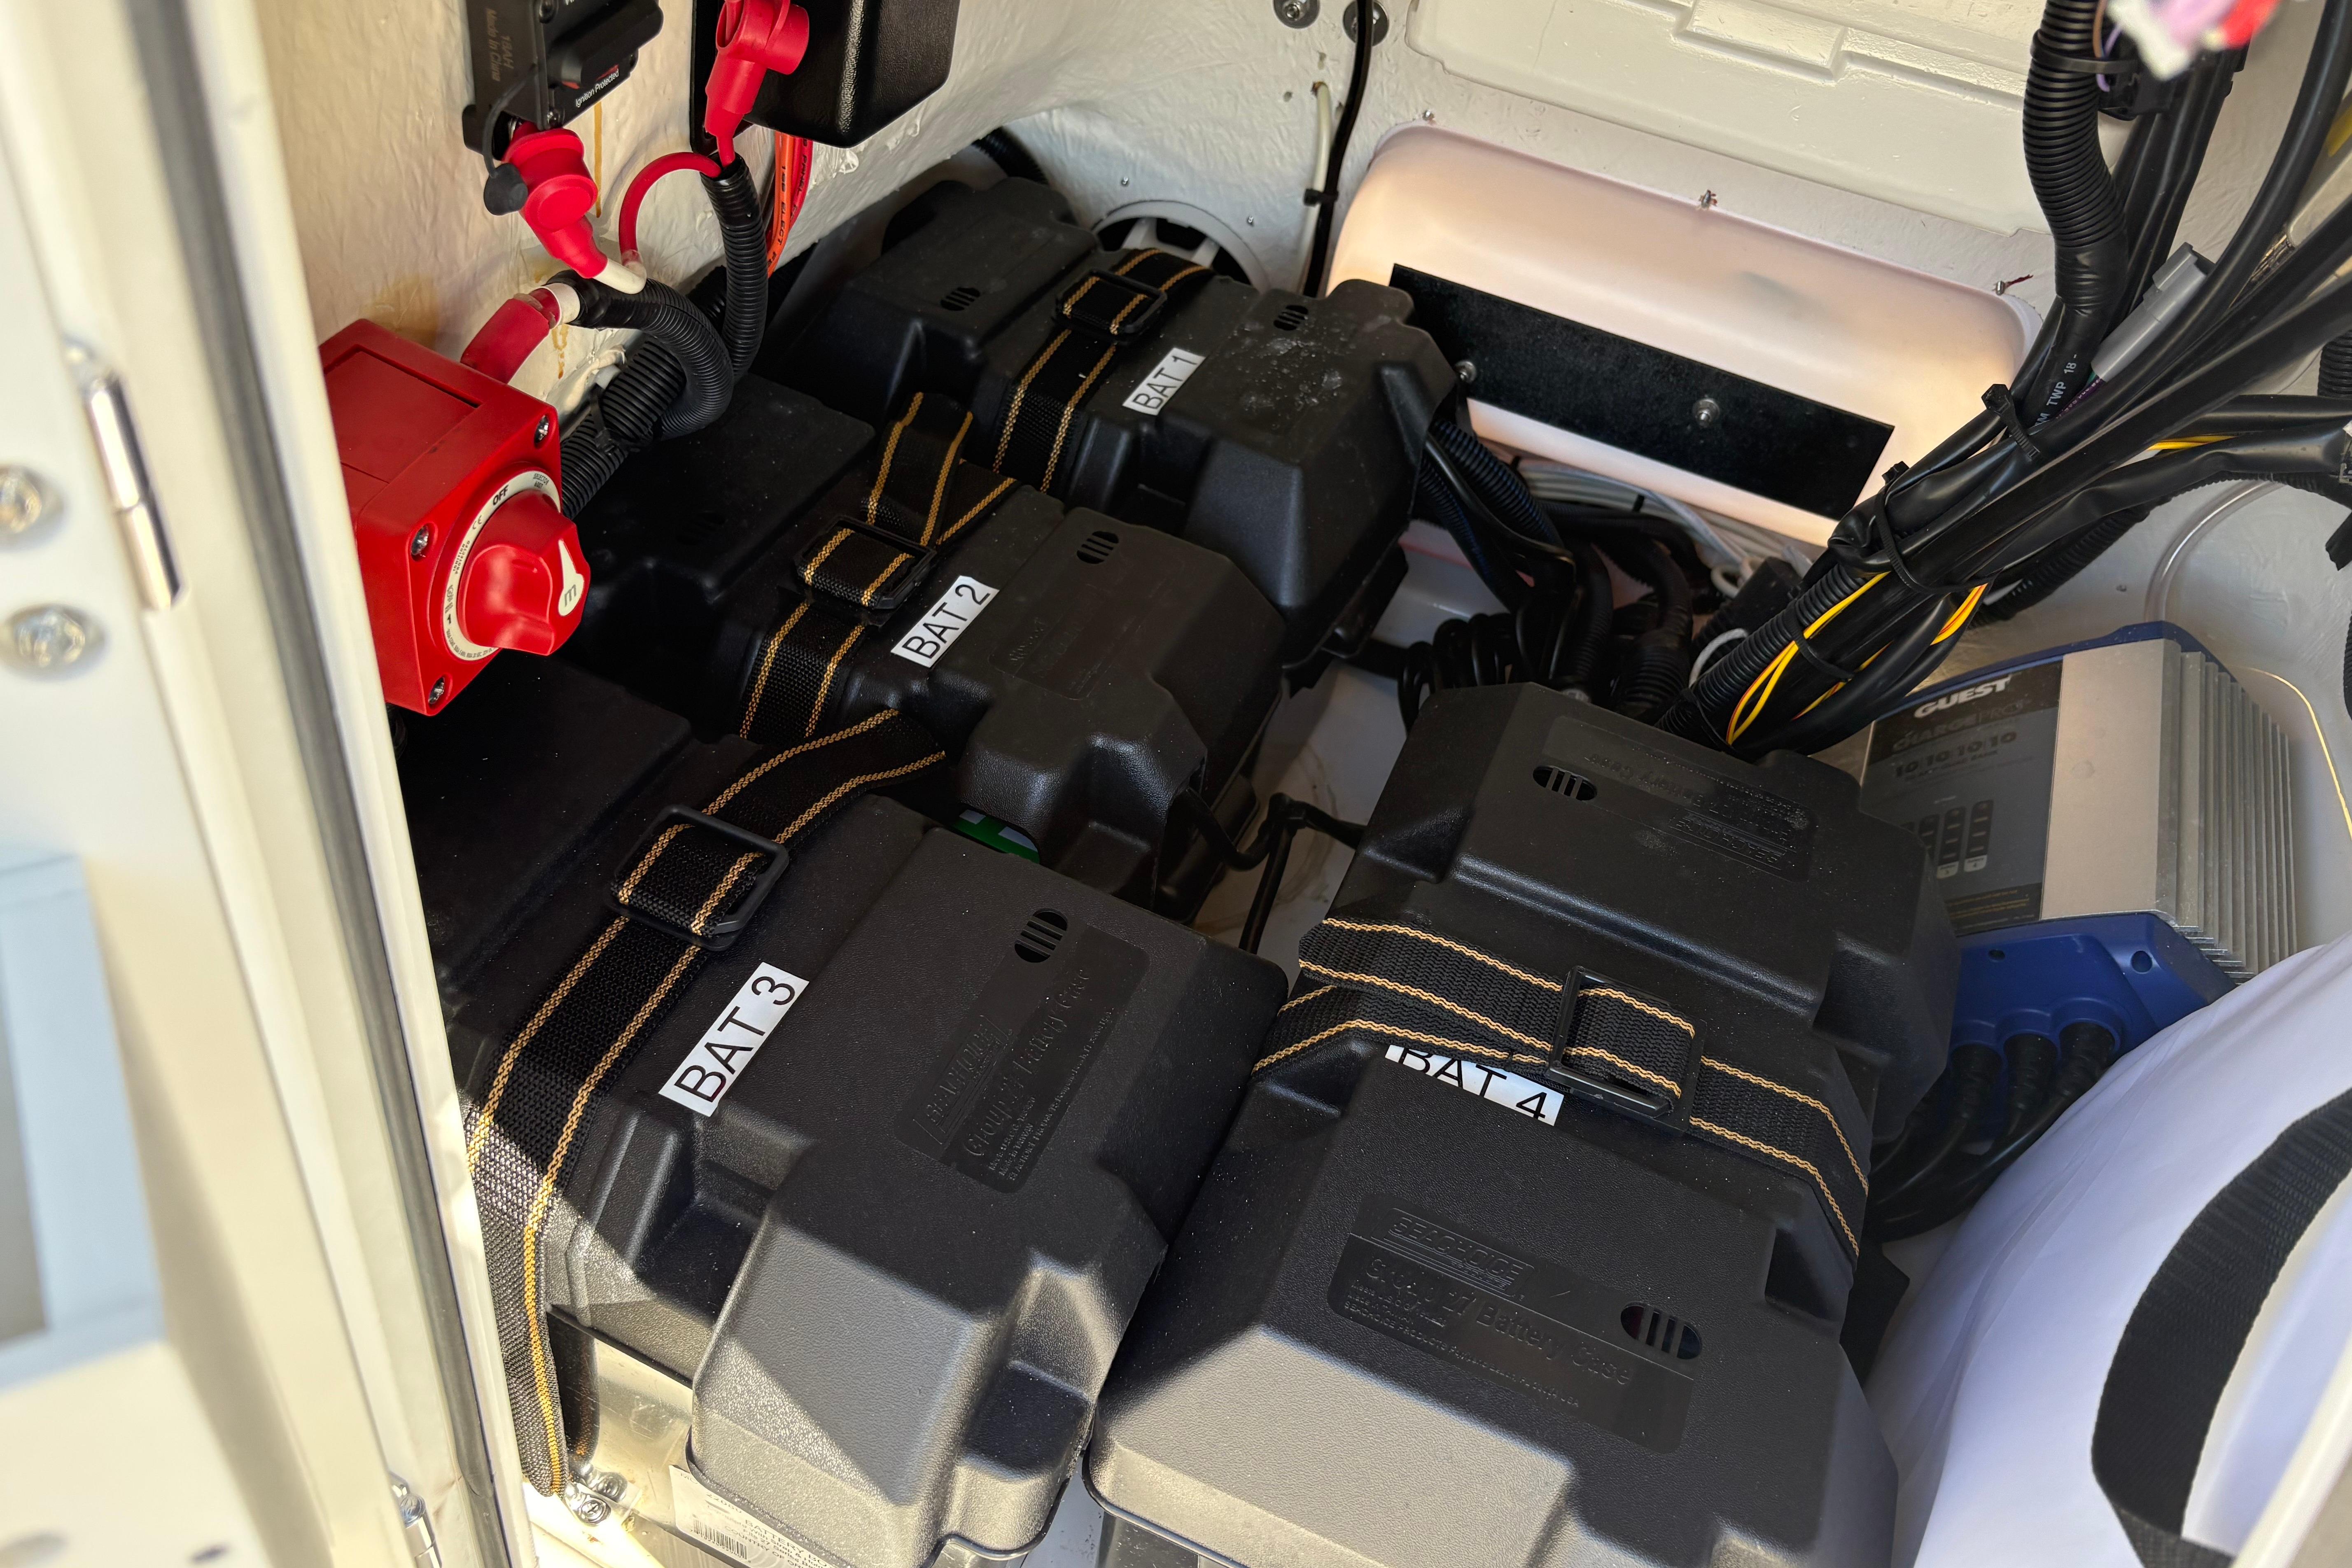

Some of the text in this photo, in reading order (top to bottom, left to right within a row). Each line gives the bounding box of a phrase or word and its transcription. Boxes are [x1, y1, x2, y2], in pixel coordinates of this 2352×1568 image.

[576, 68, 619, 107] Ignition Protected
[1133, 355, 1199, 409] BAT 1
[2046, 382, 2066, 406] TWP
[2064, 362, 2077, 373] 18
[492, 485, 509, 506] OFF
[901, 602, 966, 658] BAT
[954, 583, 992, 606] 2
[1915, 674, 2011, 718] GUEST
[674, 974, 796, 1102] BAT 3
[1516, 1092, 1547, 1119] 4
[1390, 1217, 1524, 1281] SEACHOICE
[1343, 1298, 1398, 1331] SEACHOICE
[1397, 1322, 1449, 1353] PRODUCTS
[1477, 1307, 1566, 1360] Battery
[1571, 1345, 1633, 1385] Case
[725, 1526, 770, 1552] COUNTRY
[746, 1519, 804, 1553] BATTERY
[809, 1554, 827, 1567] BO
[750, 1528, 768, 1540] With
